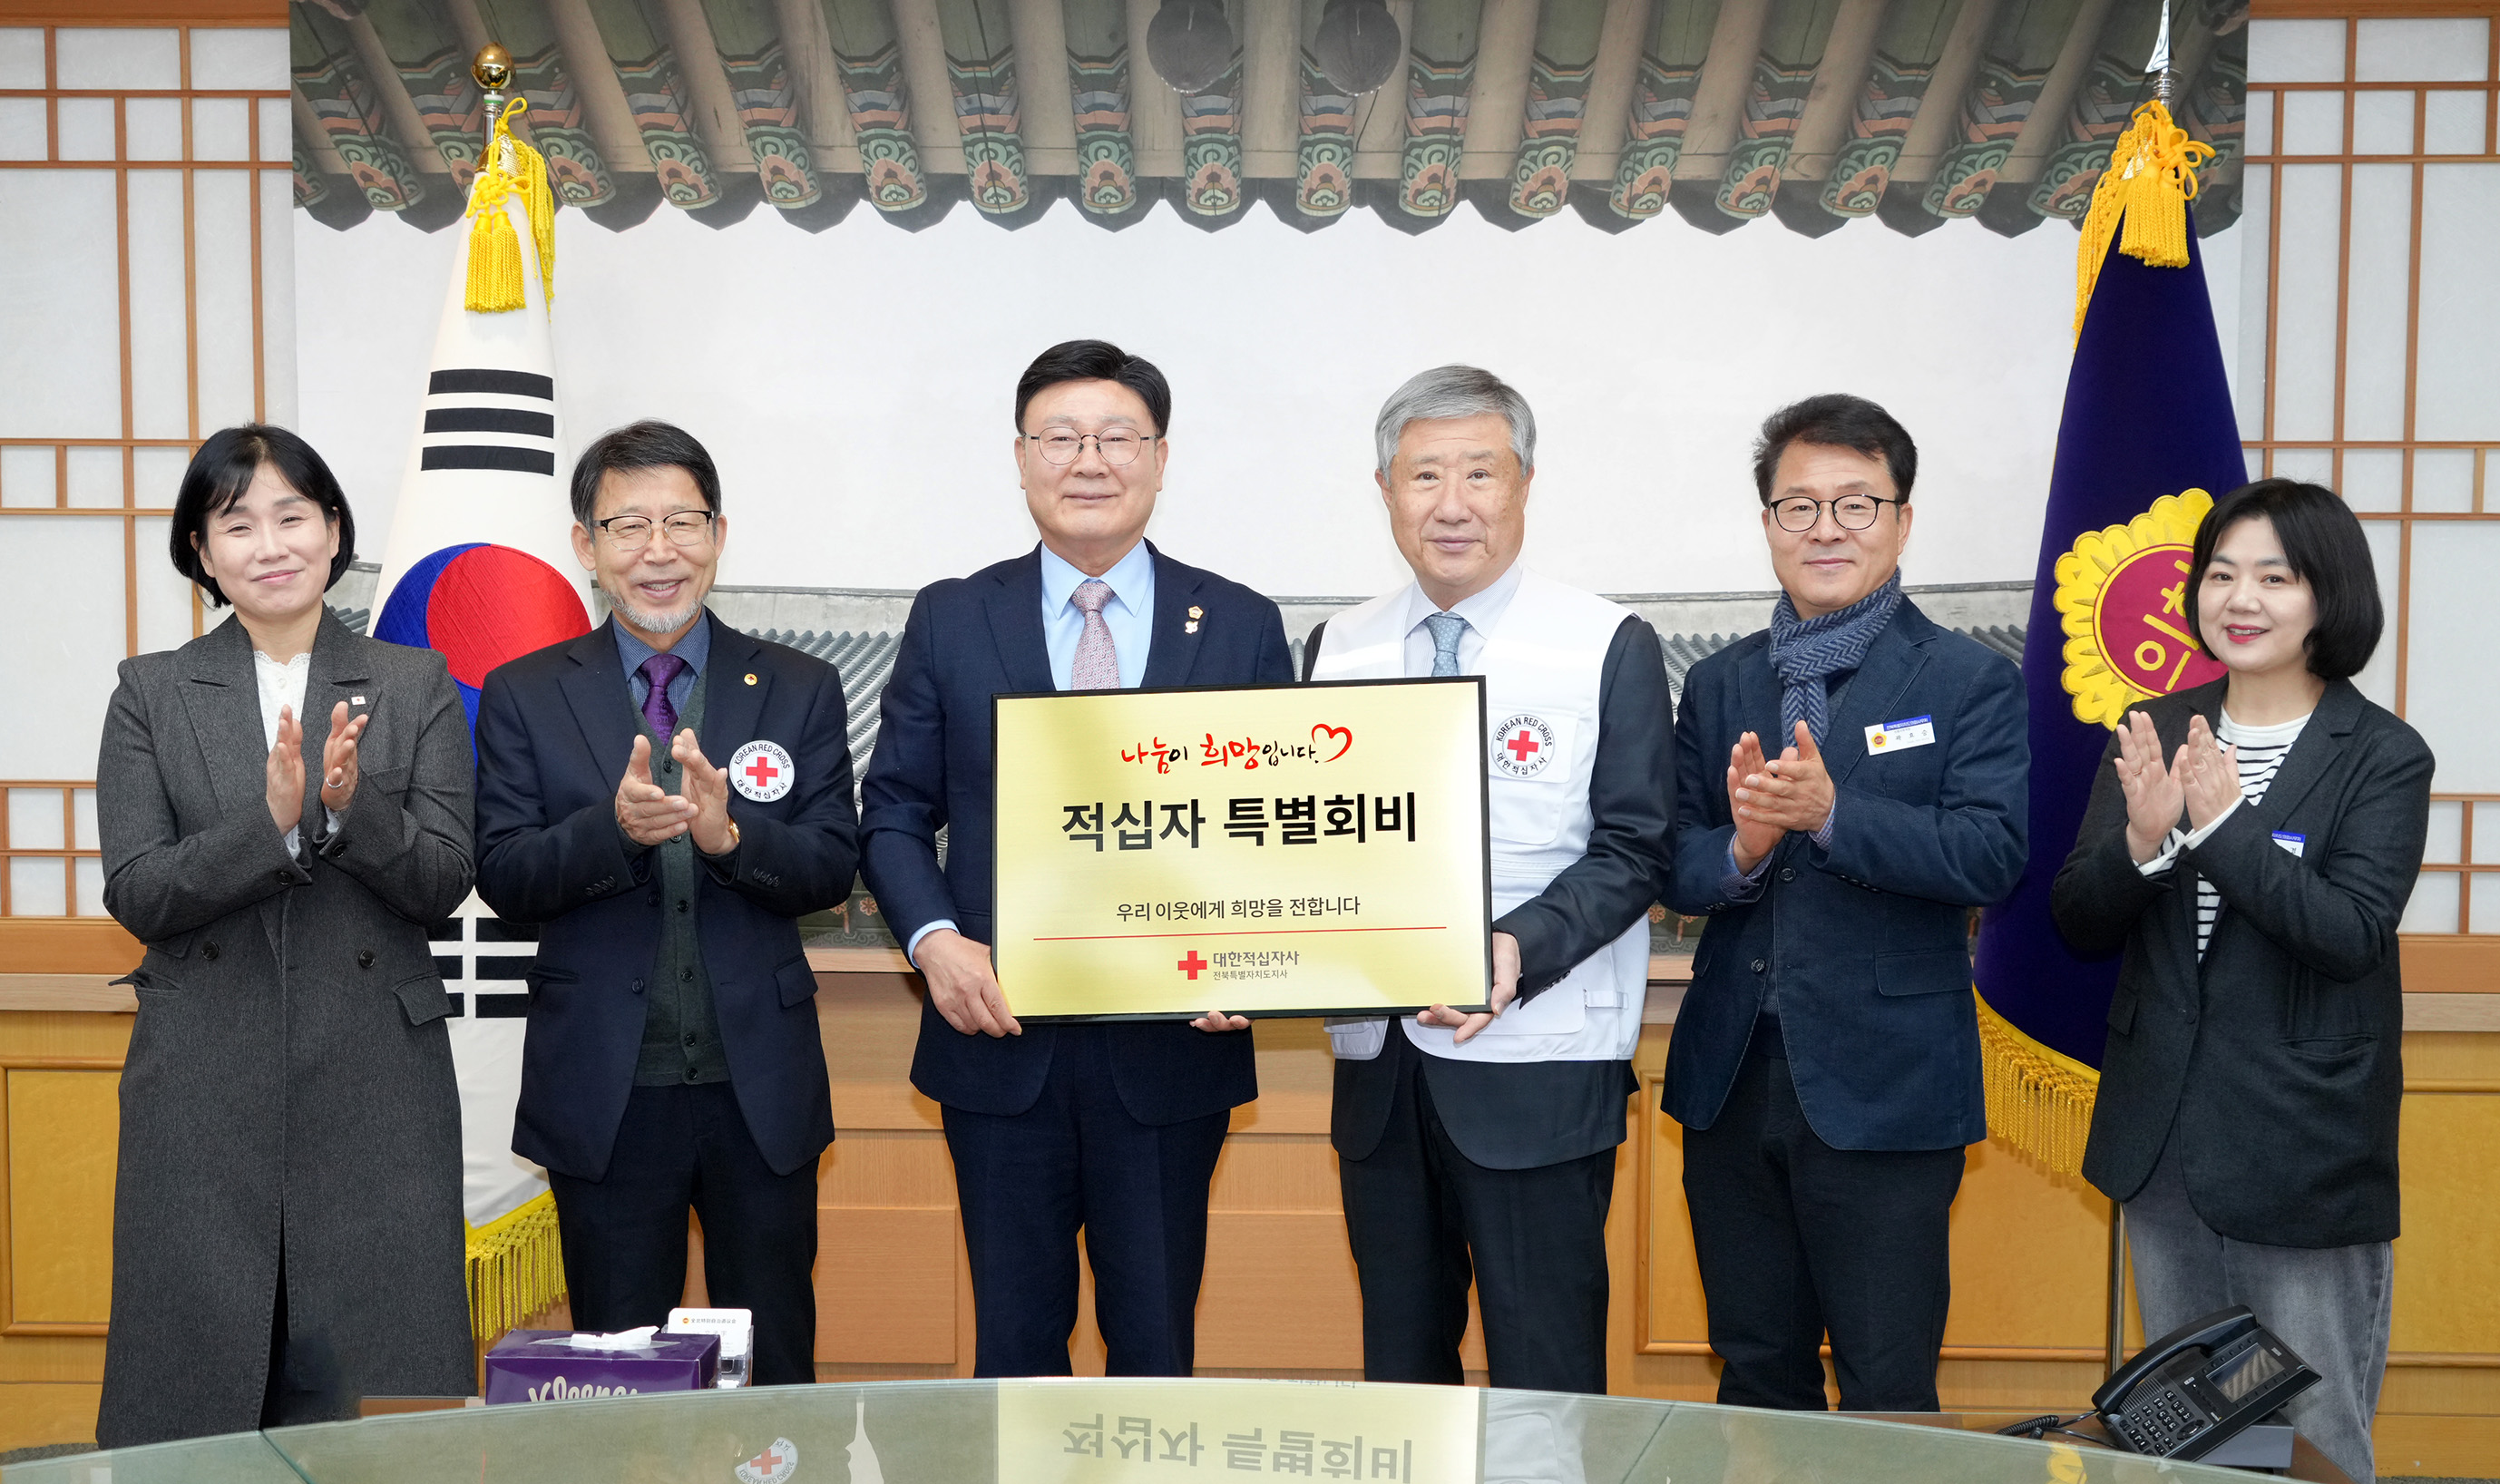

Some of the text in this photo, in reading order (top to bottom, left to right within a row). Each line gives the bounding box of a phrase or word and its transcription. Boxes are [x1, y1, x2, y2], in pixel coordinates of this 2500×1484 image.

[1496, 717, 1553, 747] KOREAN RED CROSS
[734, 743, 791, 769] KOREAN RED CROSS
[1121, 737, 1187, 774] 나눔이
[1496, 752, 1548, 776] 대한적십자사
[737, 779, 788, 799] 대한적십자사
[1061, 792, 1416, 852] 적십자 특별회비
[1116, 895, 1361, 923] 우리 이웃에게 희망을 전합니다
[1213, 950, 1300, 968] 대한적십자사
[1213, 969, 1288, 981] 전북특별자치도지사
